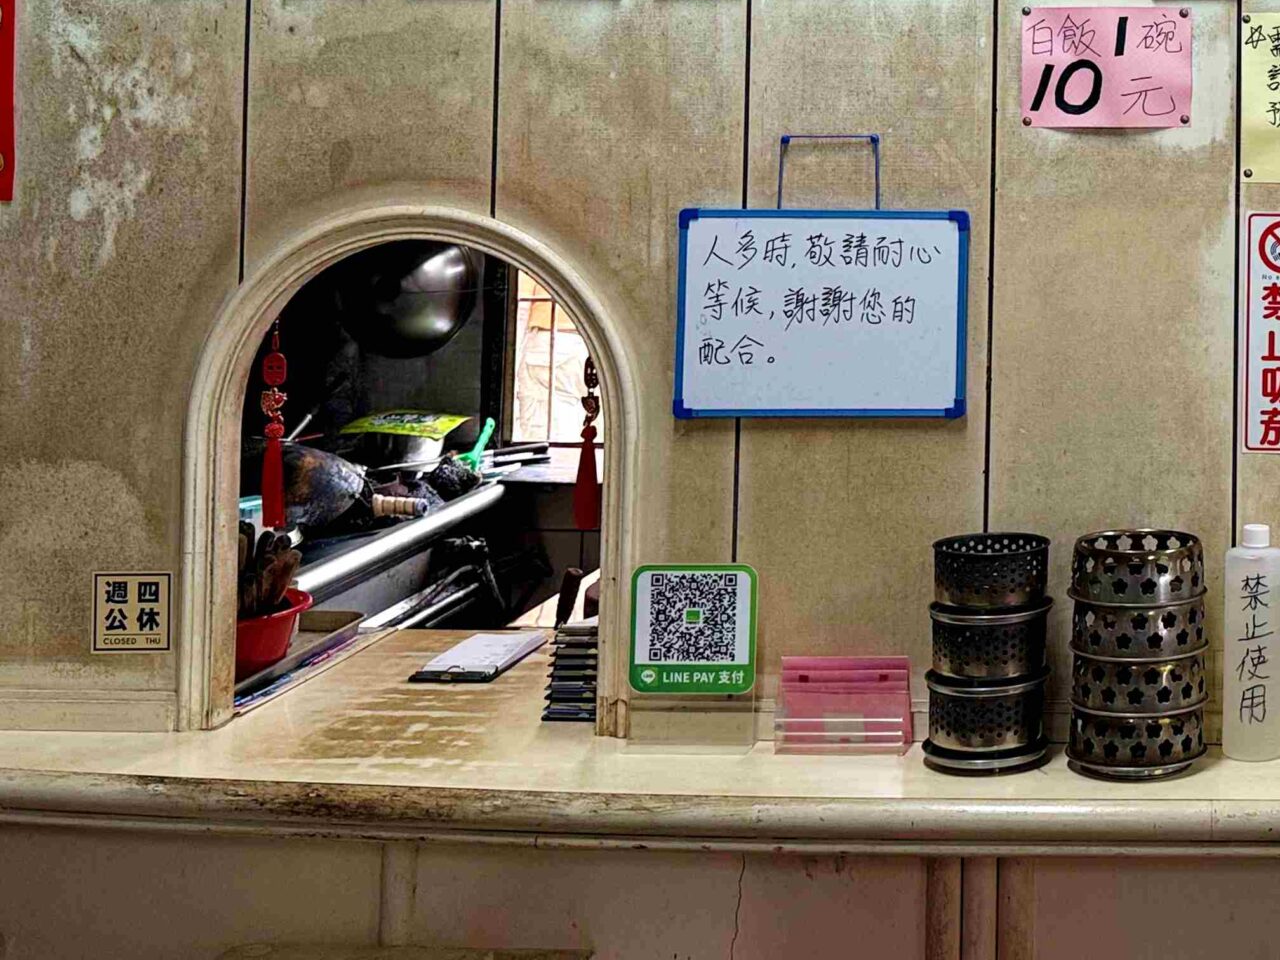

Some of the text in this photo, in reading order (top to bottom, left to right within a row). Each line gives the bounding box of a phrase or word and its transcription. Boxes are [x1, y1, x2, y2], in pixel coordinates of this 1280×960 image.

[105, 581, 160, 604] 週四
[105, 608, 160, 631] 公休
[103, 637, 161, 645] CLOSED THU
[1236, 573, 1274, 725] 禁止使用
[662, 671, 690, 683] LINE
[692, 671, 716, 683] PAY
[718, 670, 744, 684] 支付
